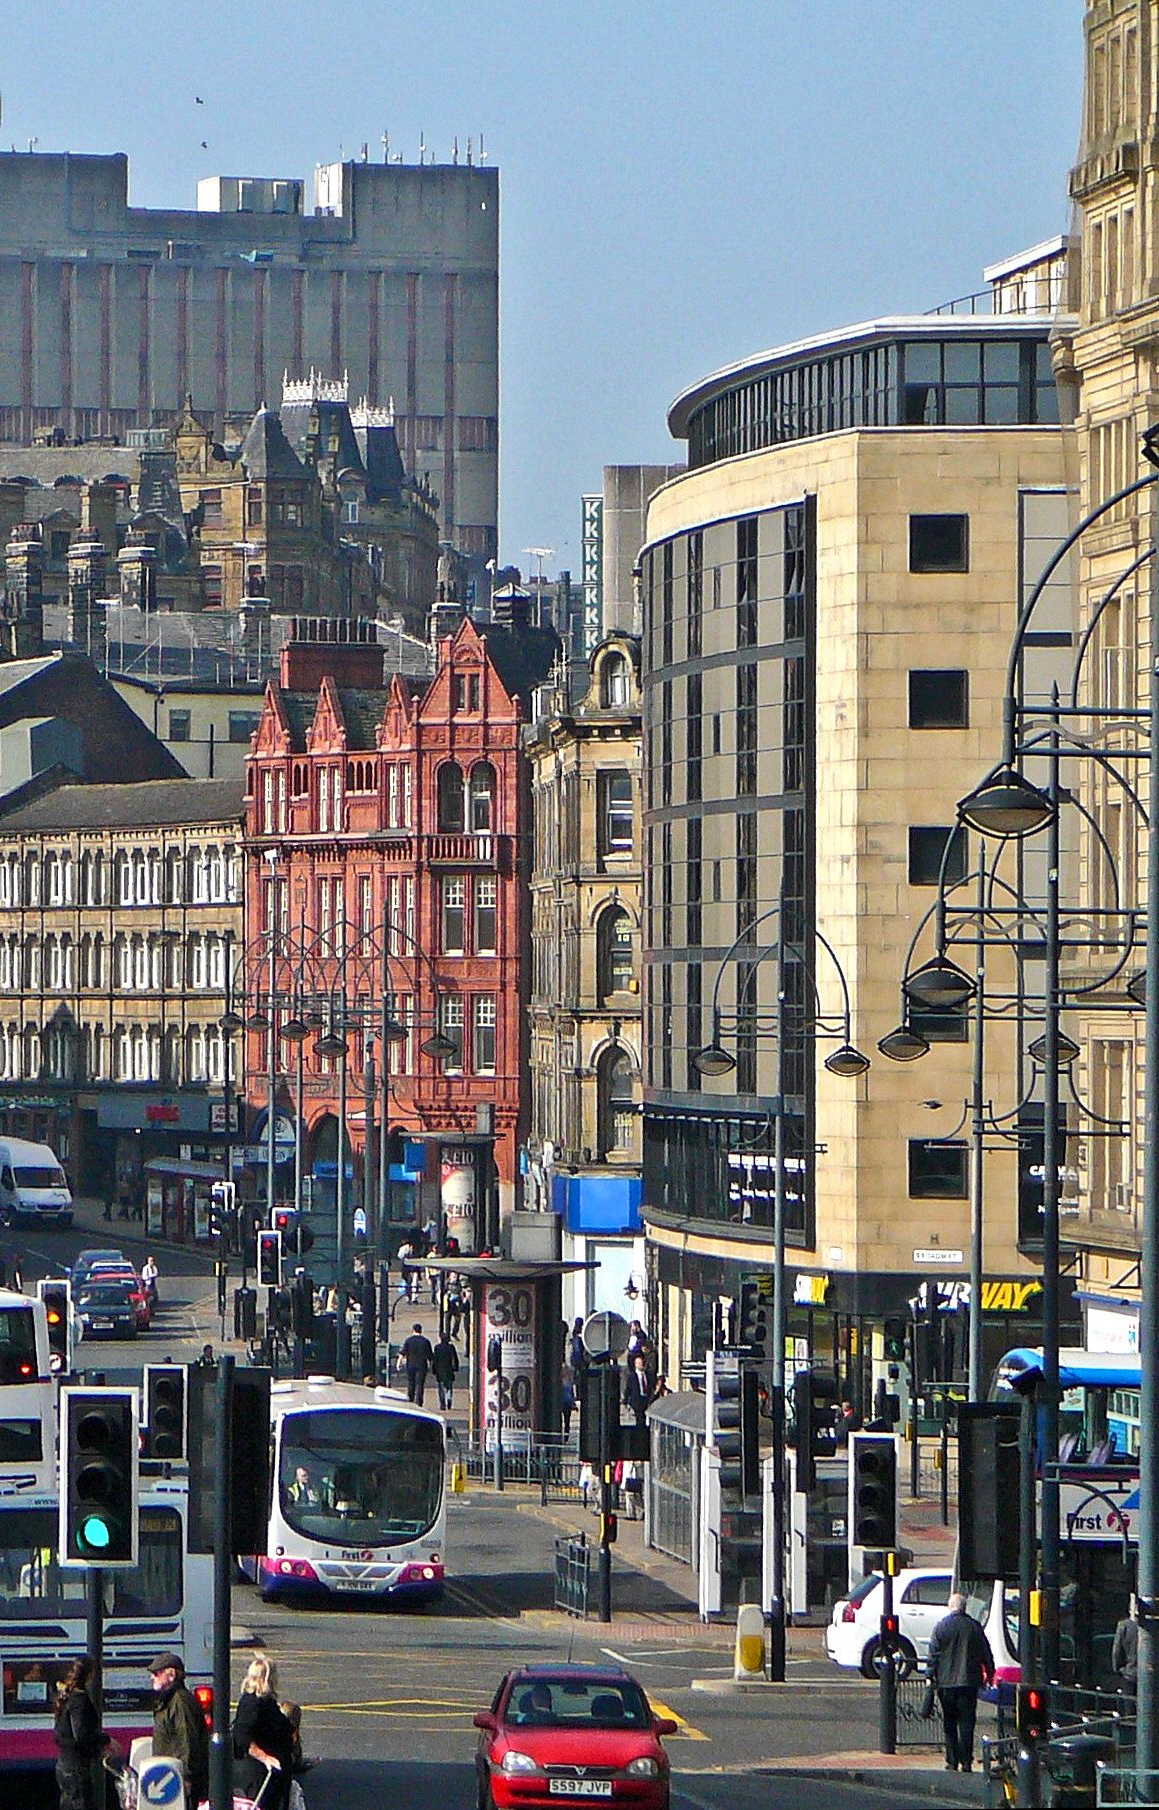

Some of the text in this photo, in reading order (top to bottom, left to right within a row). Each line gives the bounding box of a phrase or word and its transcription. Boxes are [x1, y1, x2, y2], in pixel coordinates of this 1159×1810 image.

[488, 1288, 534, 1328] 30
[487, 1374, 532, 1413] 30
[487, 1414, 531, 1429] mllion
[1067, 1513, 1102, 1530] irst
[342, 1551, 360, 1561] First
[552, 1780, 583, 1792] S597
